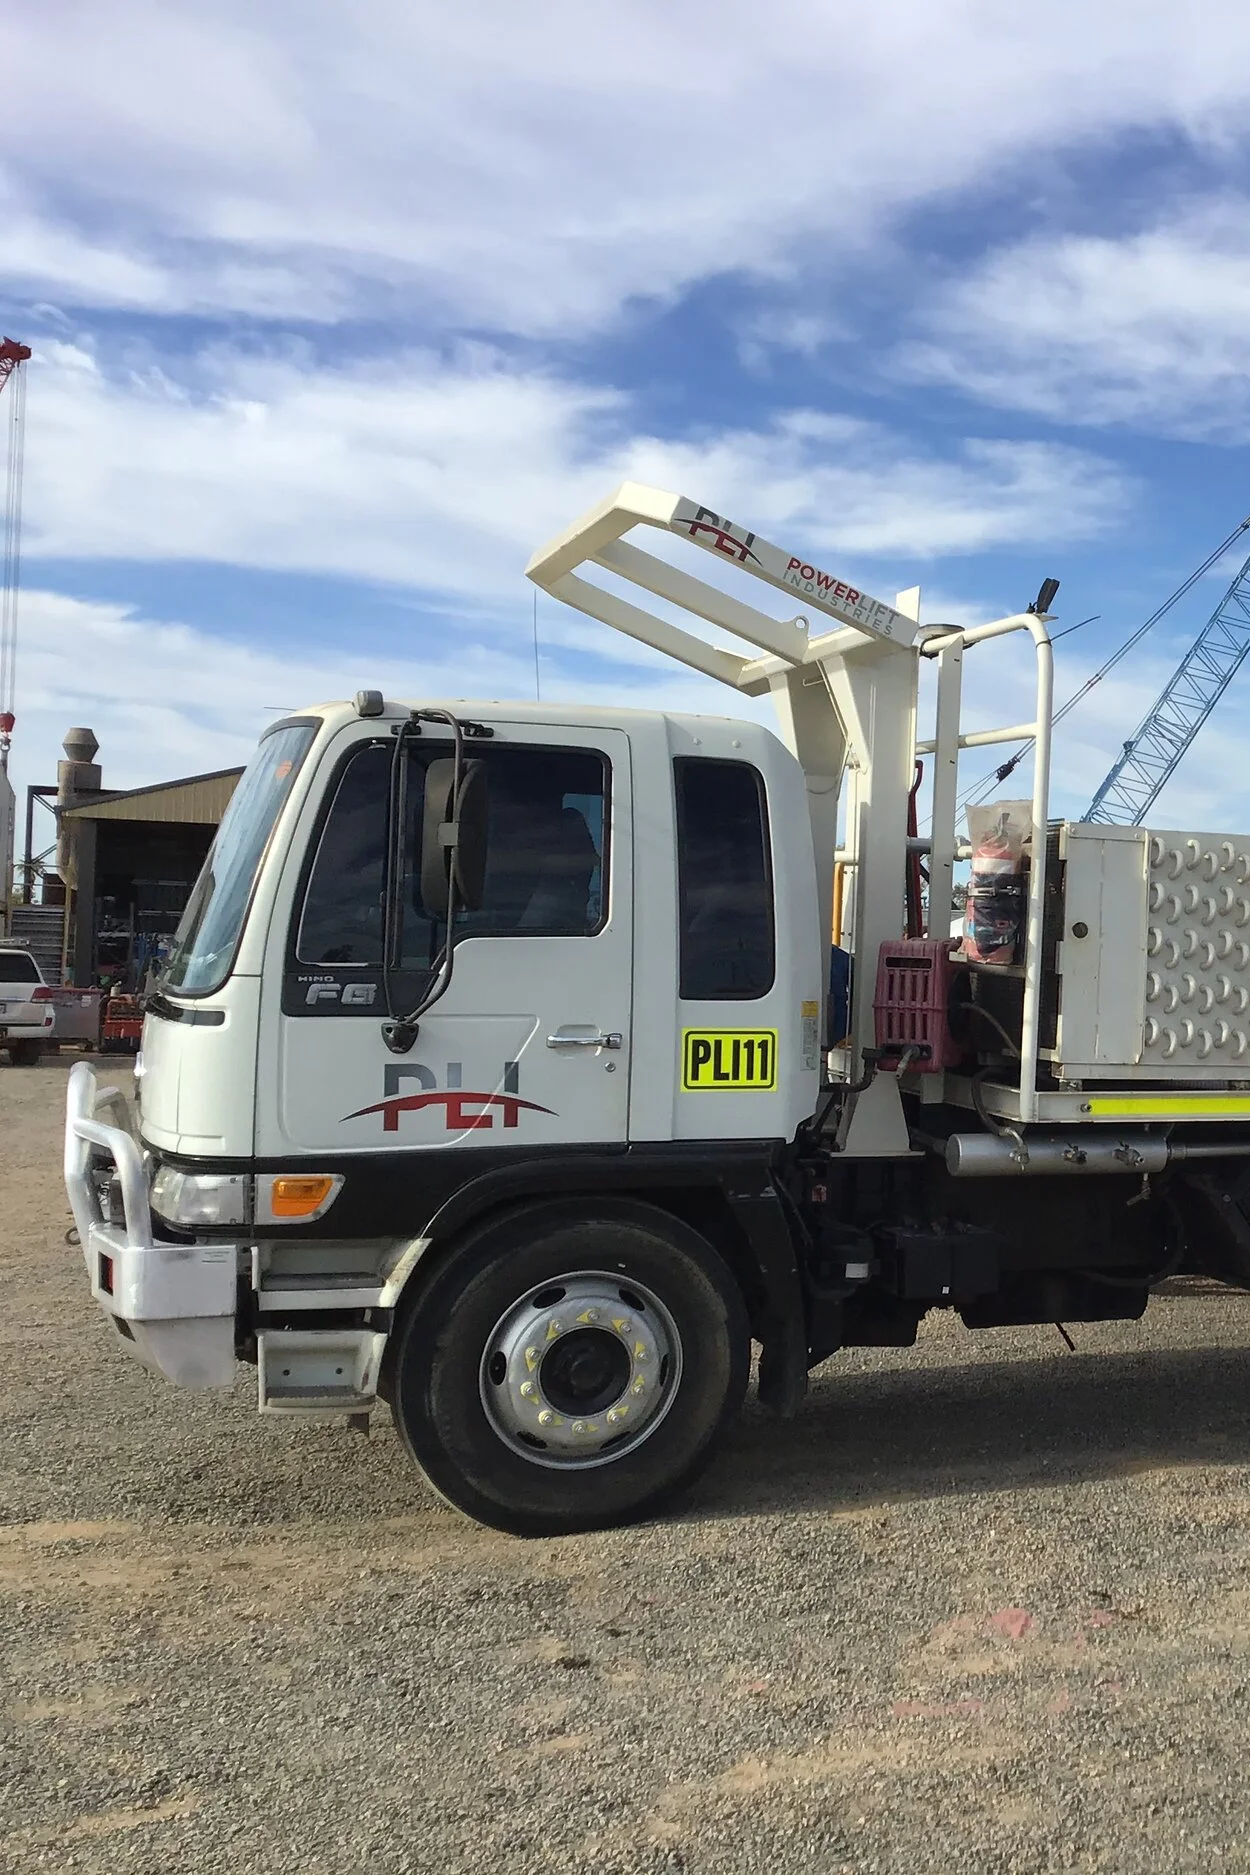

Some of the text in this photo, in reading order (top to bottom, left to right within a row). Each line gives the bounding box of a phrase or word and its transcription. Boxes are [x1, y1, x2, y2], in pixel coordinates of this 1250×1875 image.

[783, 570, 892, 635] INDUSTRIES
[786, 557, 899, 624] POWERLIFT
[305, 983, 378, 1005] FG
[691, 1039, 769, 1081] PLI11
